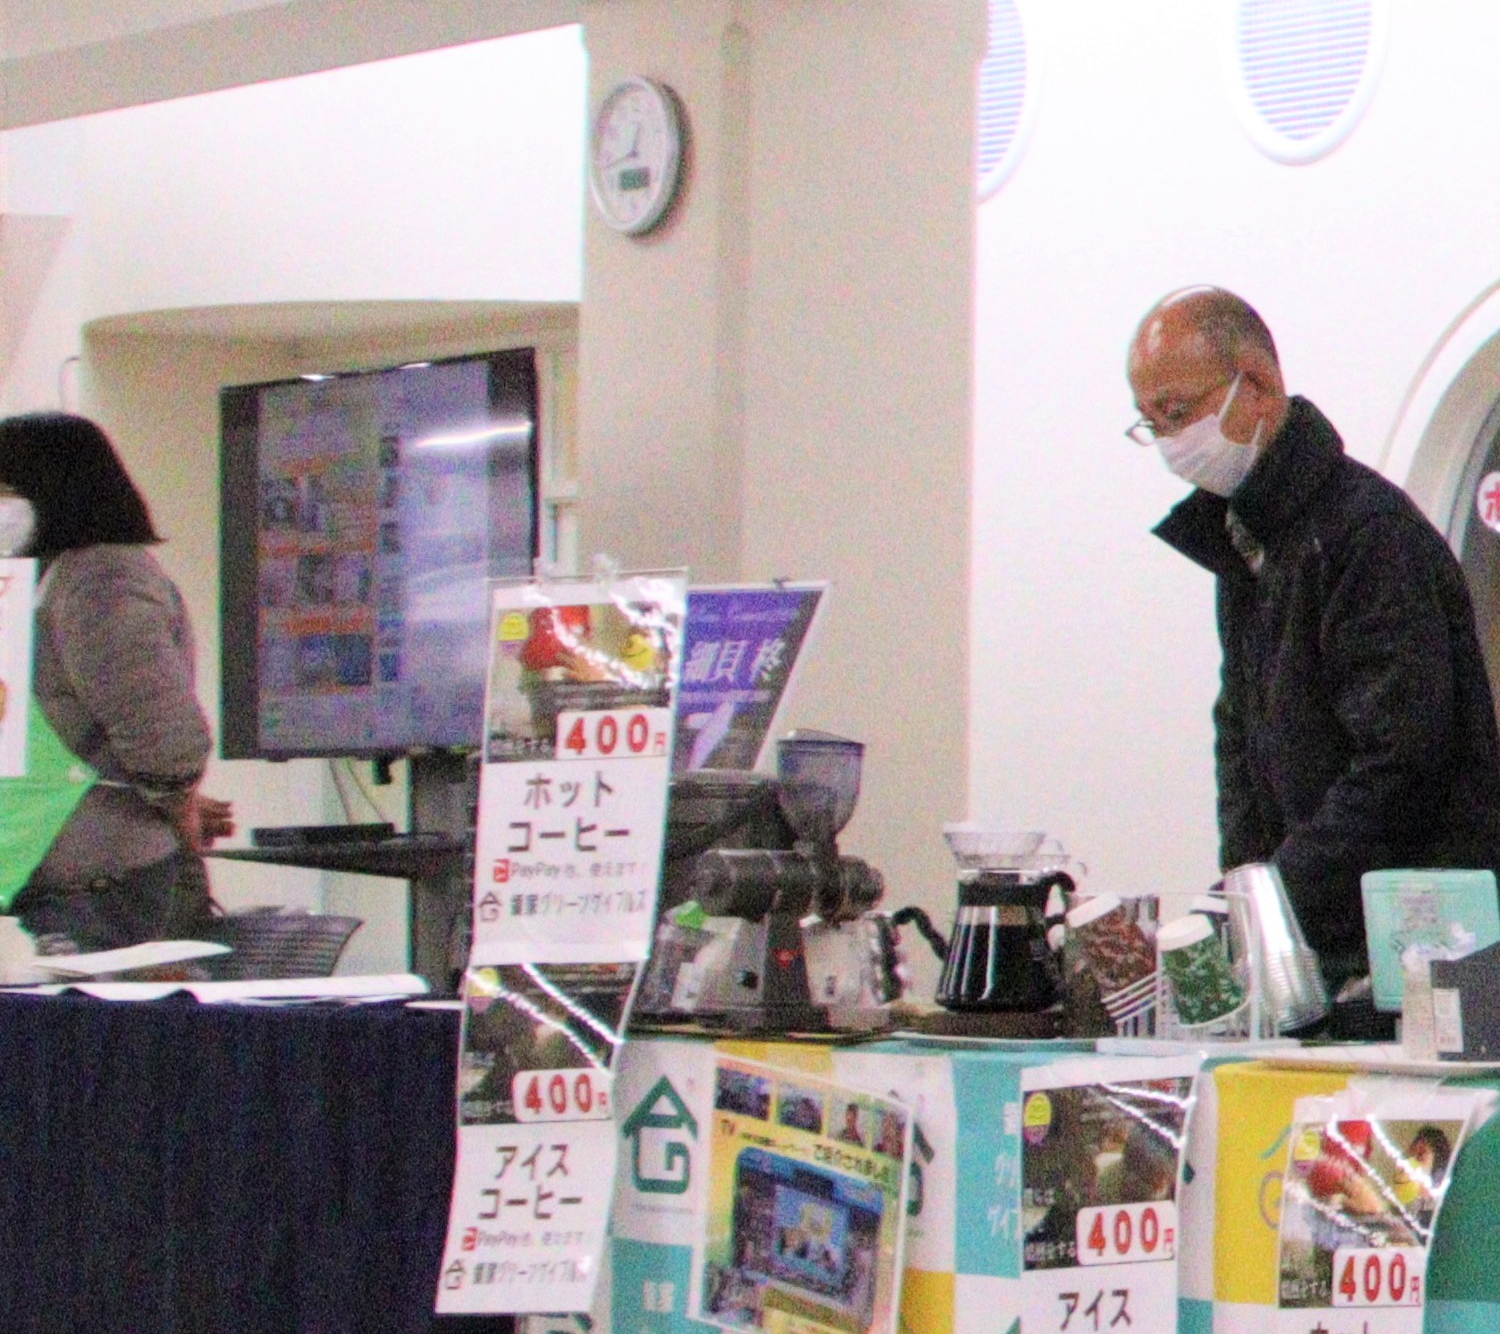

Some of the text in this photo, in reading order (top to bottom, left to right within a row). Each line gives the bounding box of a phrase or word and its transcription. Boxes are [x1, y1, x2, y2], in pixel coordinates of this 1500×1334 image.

[522, 770, 615, 810] ホット
[506, 817, 631, 853] コーヒー
[494, 1143, 571, 1181] アイス
[477, 1186, 583, 1221] コーヒー
[1087, 1205, 1175, 1259] 400円
[1338, 1252, 1421, 1305] 400円
[1057, 1287, 1134, 1334] アイス
